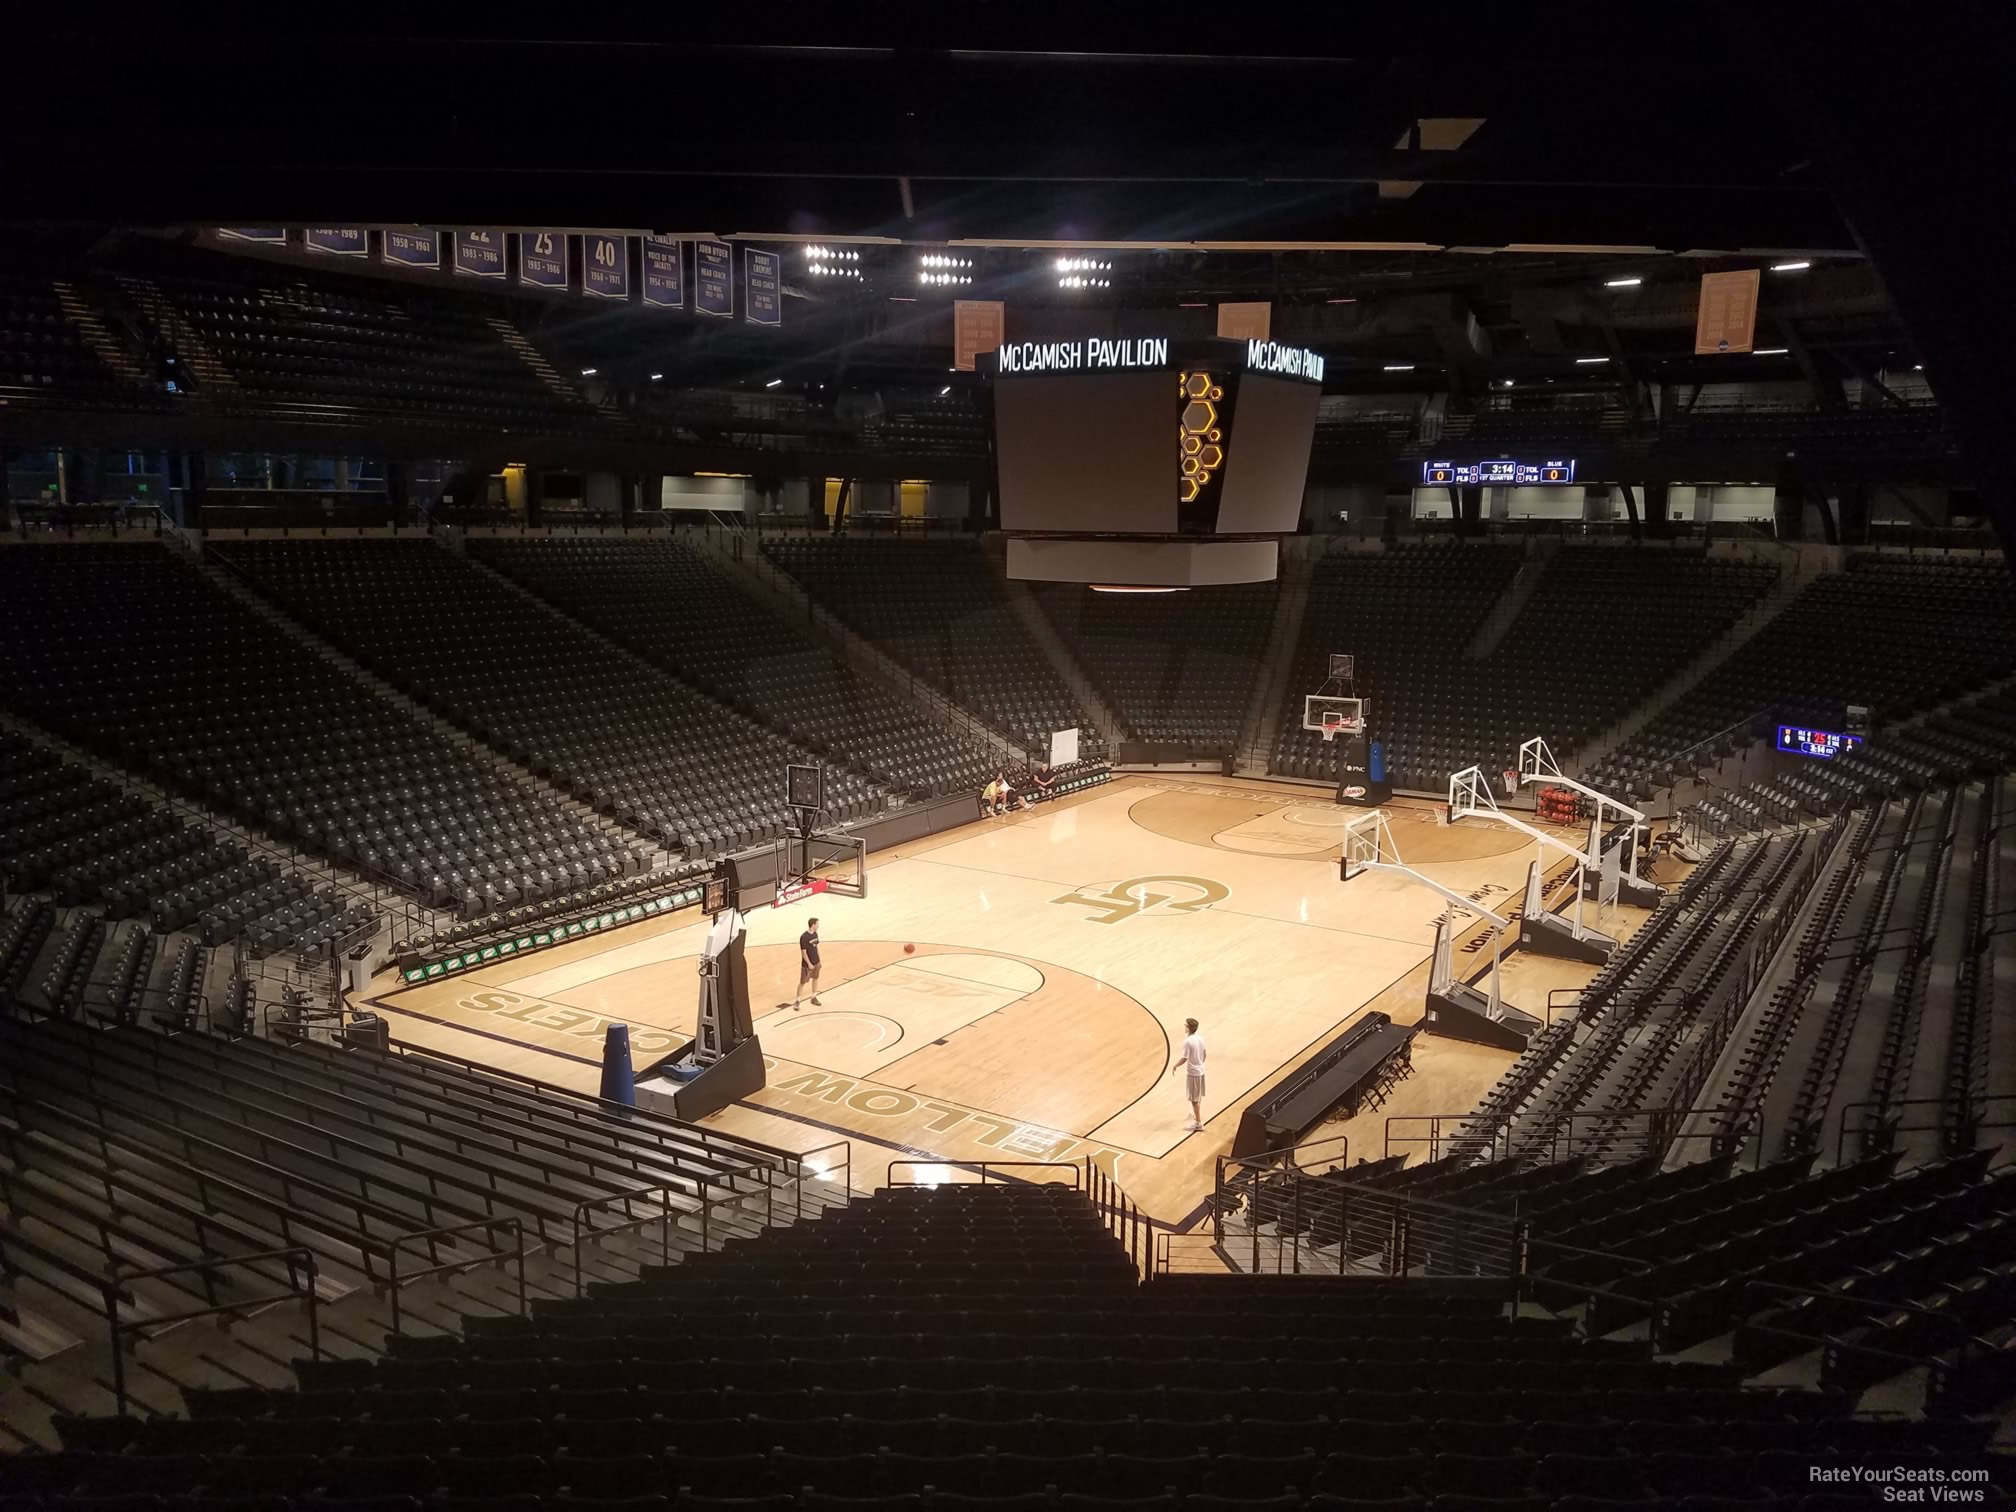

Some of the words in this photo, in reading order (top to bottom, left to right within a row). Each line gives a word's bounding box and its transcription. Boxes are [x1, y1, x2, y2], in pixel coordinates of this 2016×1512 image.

[416, 240, 430, 252] 1961
[595, 240, 615, 267] 40
[653, 260, 672, 271] JACKETS
[1087, 338, 1168, 367] PAVILION
[1492, 464, 1514, 474] 3:14
[1437, 471, 1445, 481] 0
[1550, 470, 1558, 480] 0
